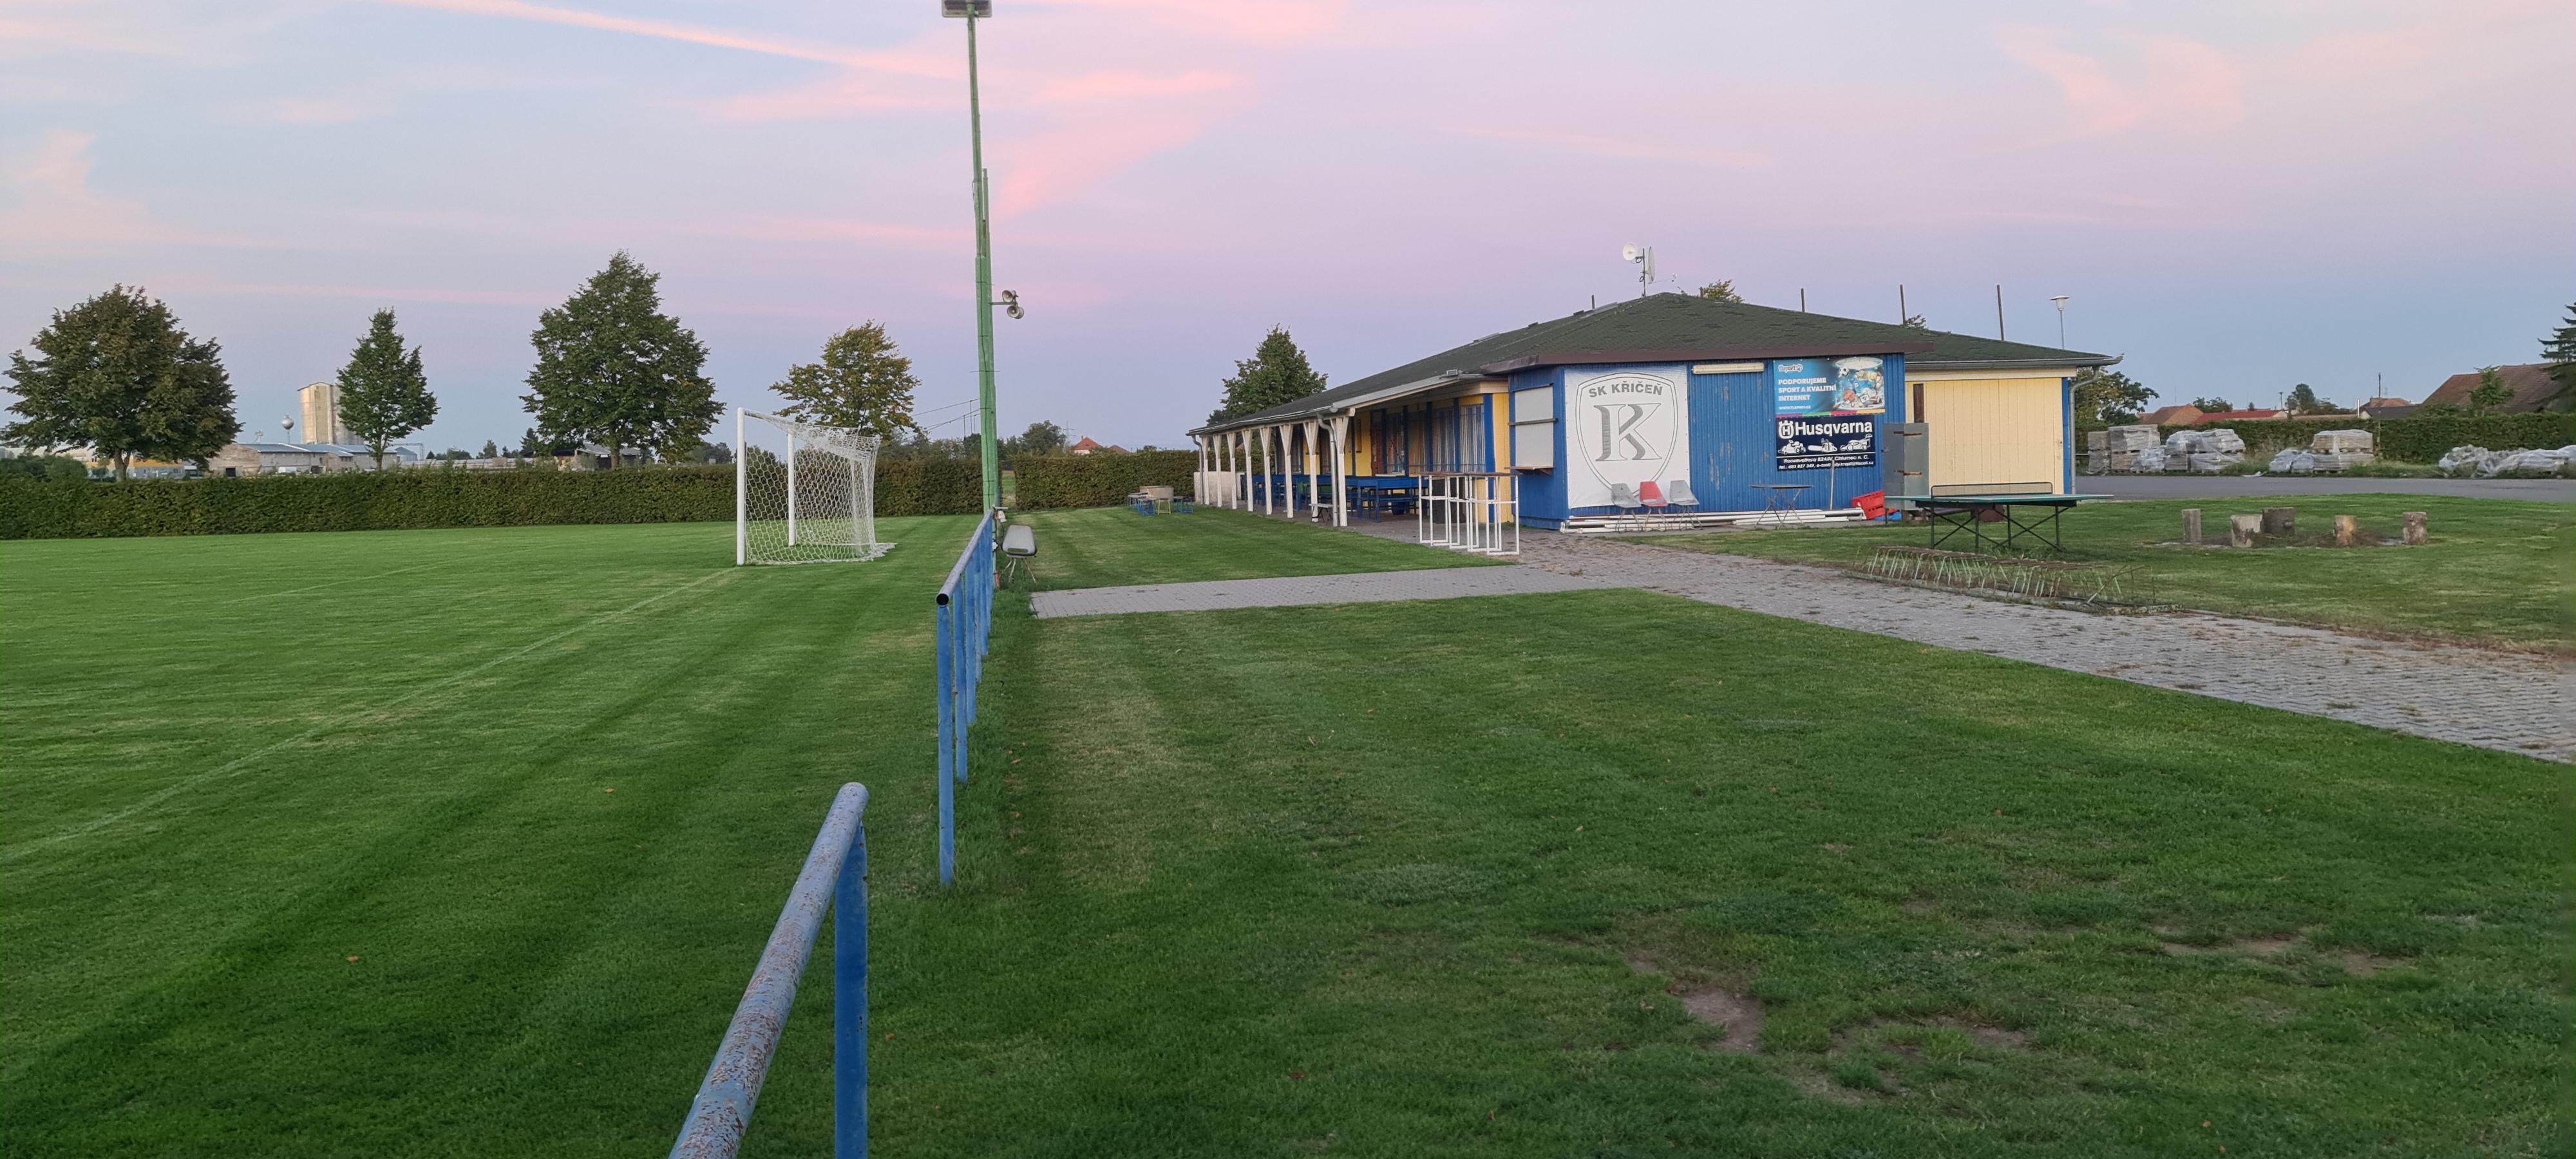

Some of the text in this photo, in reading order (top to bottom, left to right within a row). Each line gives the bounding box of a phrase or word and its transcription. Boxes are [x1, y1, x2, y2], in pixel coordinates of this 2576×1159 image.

[1589, 381, 1663, 397] SK KŘIČEŇ
[1807, 384, 1837, 392] KVALITNÍ
[1795, 421, 1873, 437] Husqvarna
